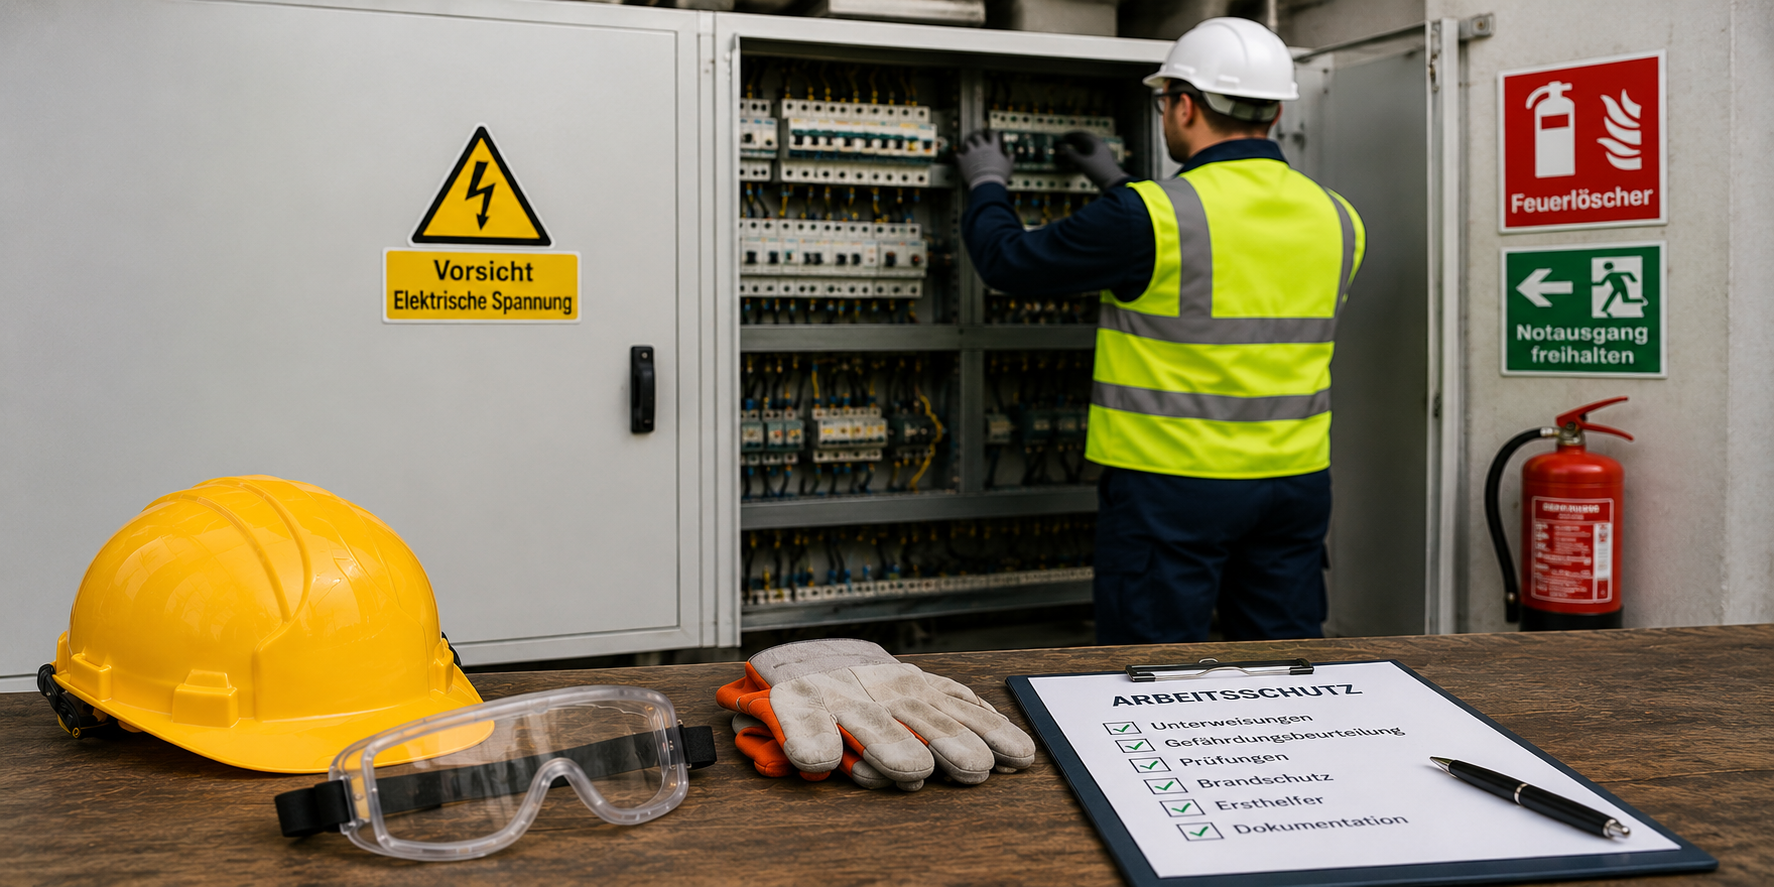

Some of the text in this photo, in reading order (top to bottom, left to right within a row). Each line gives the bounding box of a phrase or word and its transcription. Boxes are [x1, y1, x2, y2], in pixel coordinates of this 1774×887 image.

[1511, 186, 1653, 214] Feuerlöscher
[433, 260, 534, 282] Vorsicht
[394, 290, 572, 315] Elektrische Spannung
[1516, 324, 1648, 345] Notausgang
[1531, 346, 1634, 364] freihalten
[1112, 683, 1362, 707] ARBEITSSCHUTZ
[1151, 712, 1313, 731] Unterweisungen
[1164, 725, 1406, 748] Gefährdungsbeurteilung
[1180, 752, 1289, 767] Prüfungen
[1197, 771, 1334, 789] Brandschutz
[1215, 795, 1323, 811] Ersthelfer
[1233, 814, 1409, 835] Dokumentation
